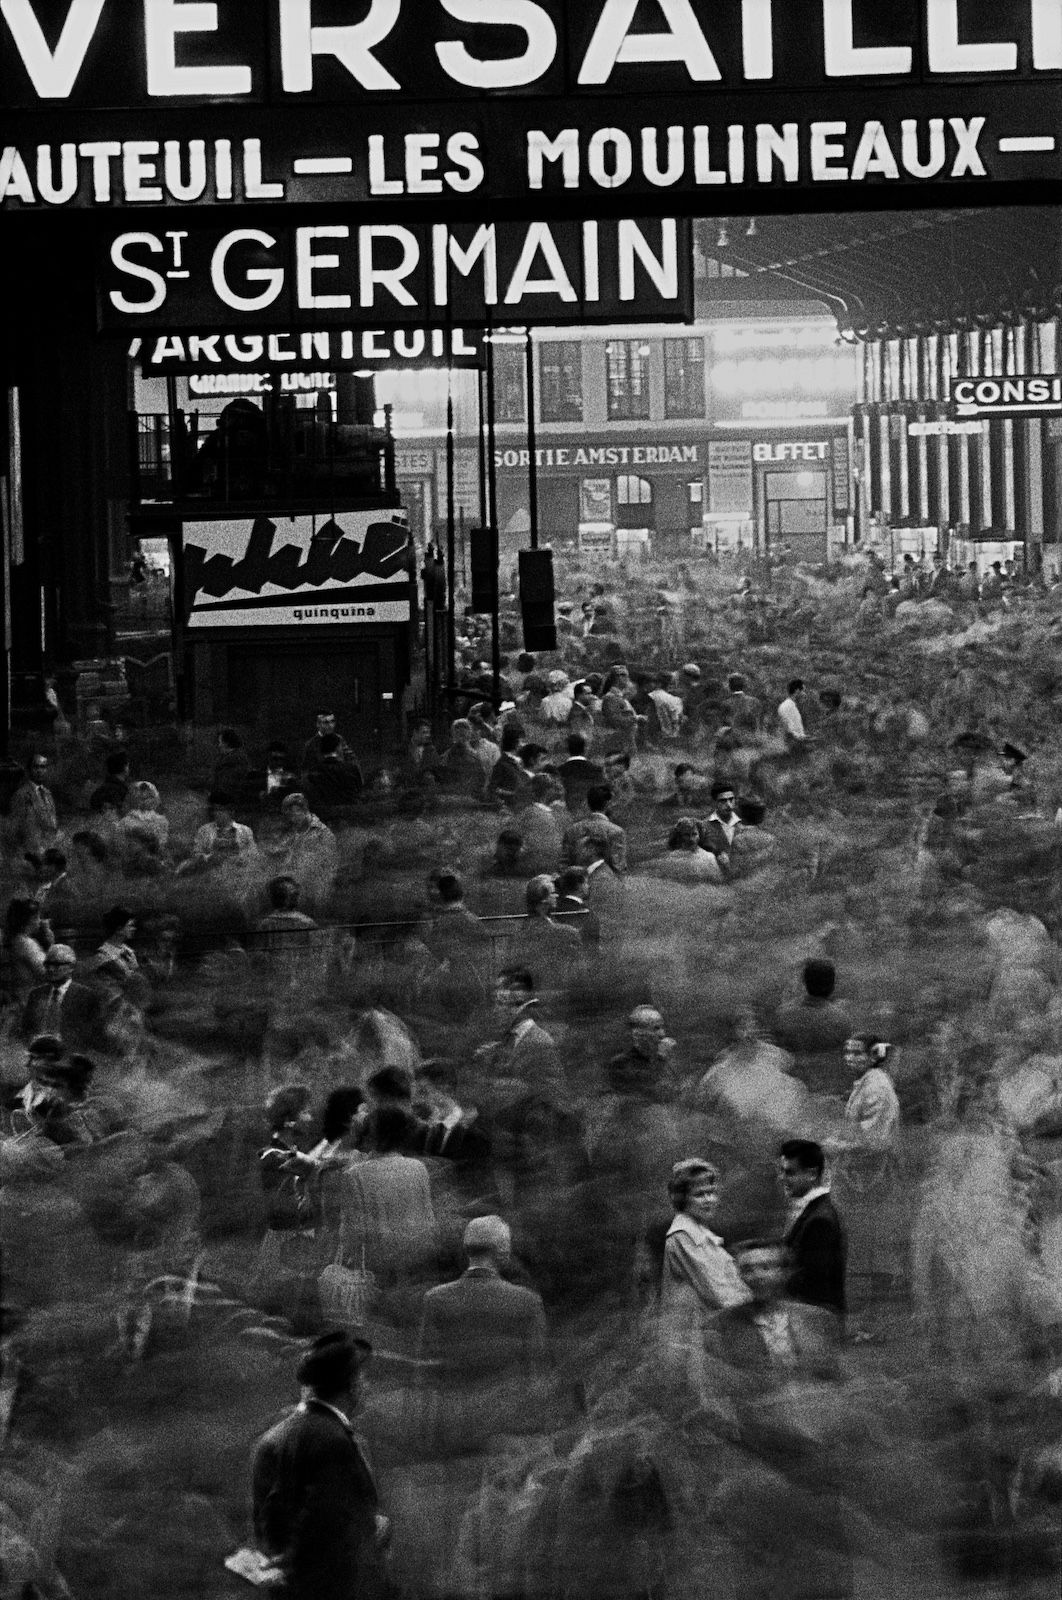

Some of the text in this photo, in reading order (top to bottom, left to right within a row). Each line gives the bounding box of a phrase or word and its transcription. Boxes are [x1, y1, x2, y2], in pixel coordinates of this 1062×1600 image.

[0, 0, 1062, 98] VERSAILL
[0, 139, 283, 203] AUTEUIL
[369, 132, 484, 194] LES
[528, 117, 986, 189] MOULINEAUX
[211, 218, 677, 311] GERMAIN
[494, 449, 569, 467] SORTIE
[574, 446, 698, 464] AMSTERDAM
[753, 442, 828, 461] BUFFET
[293, 608, 376, 620] quinquina
